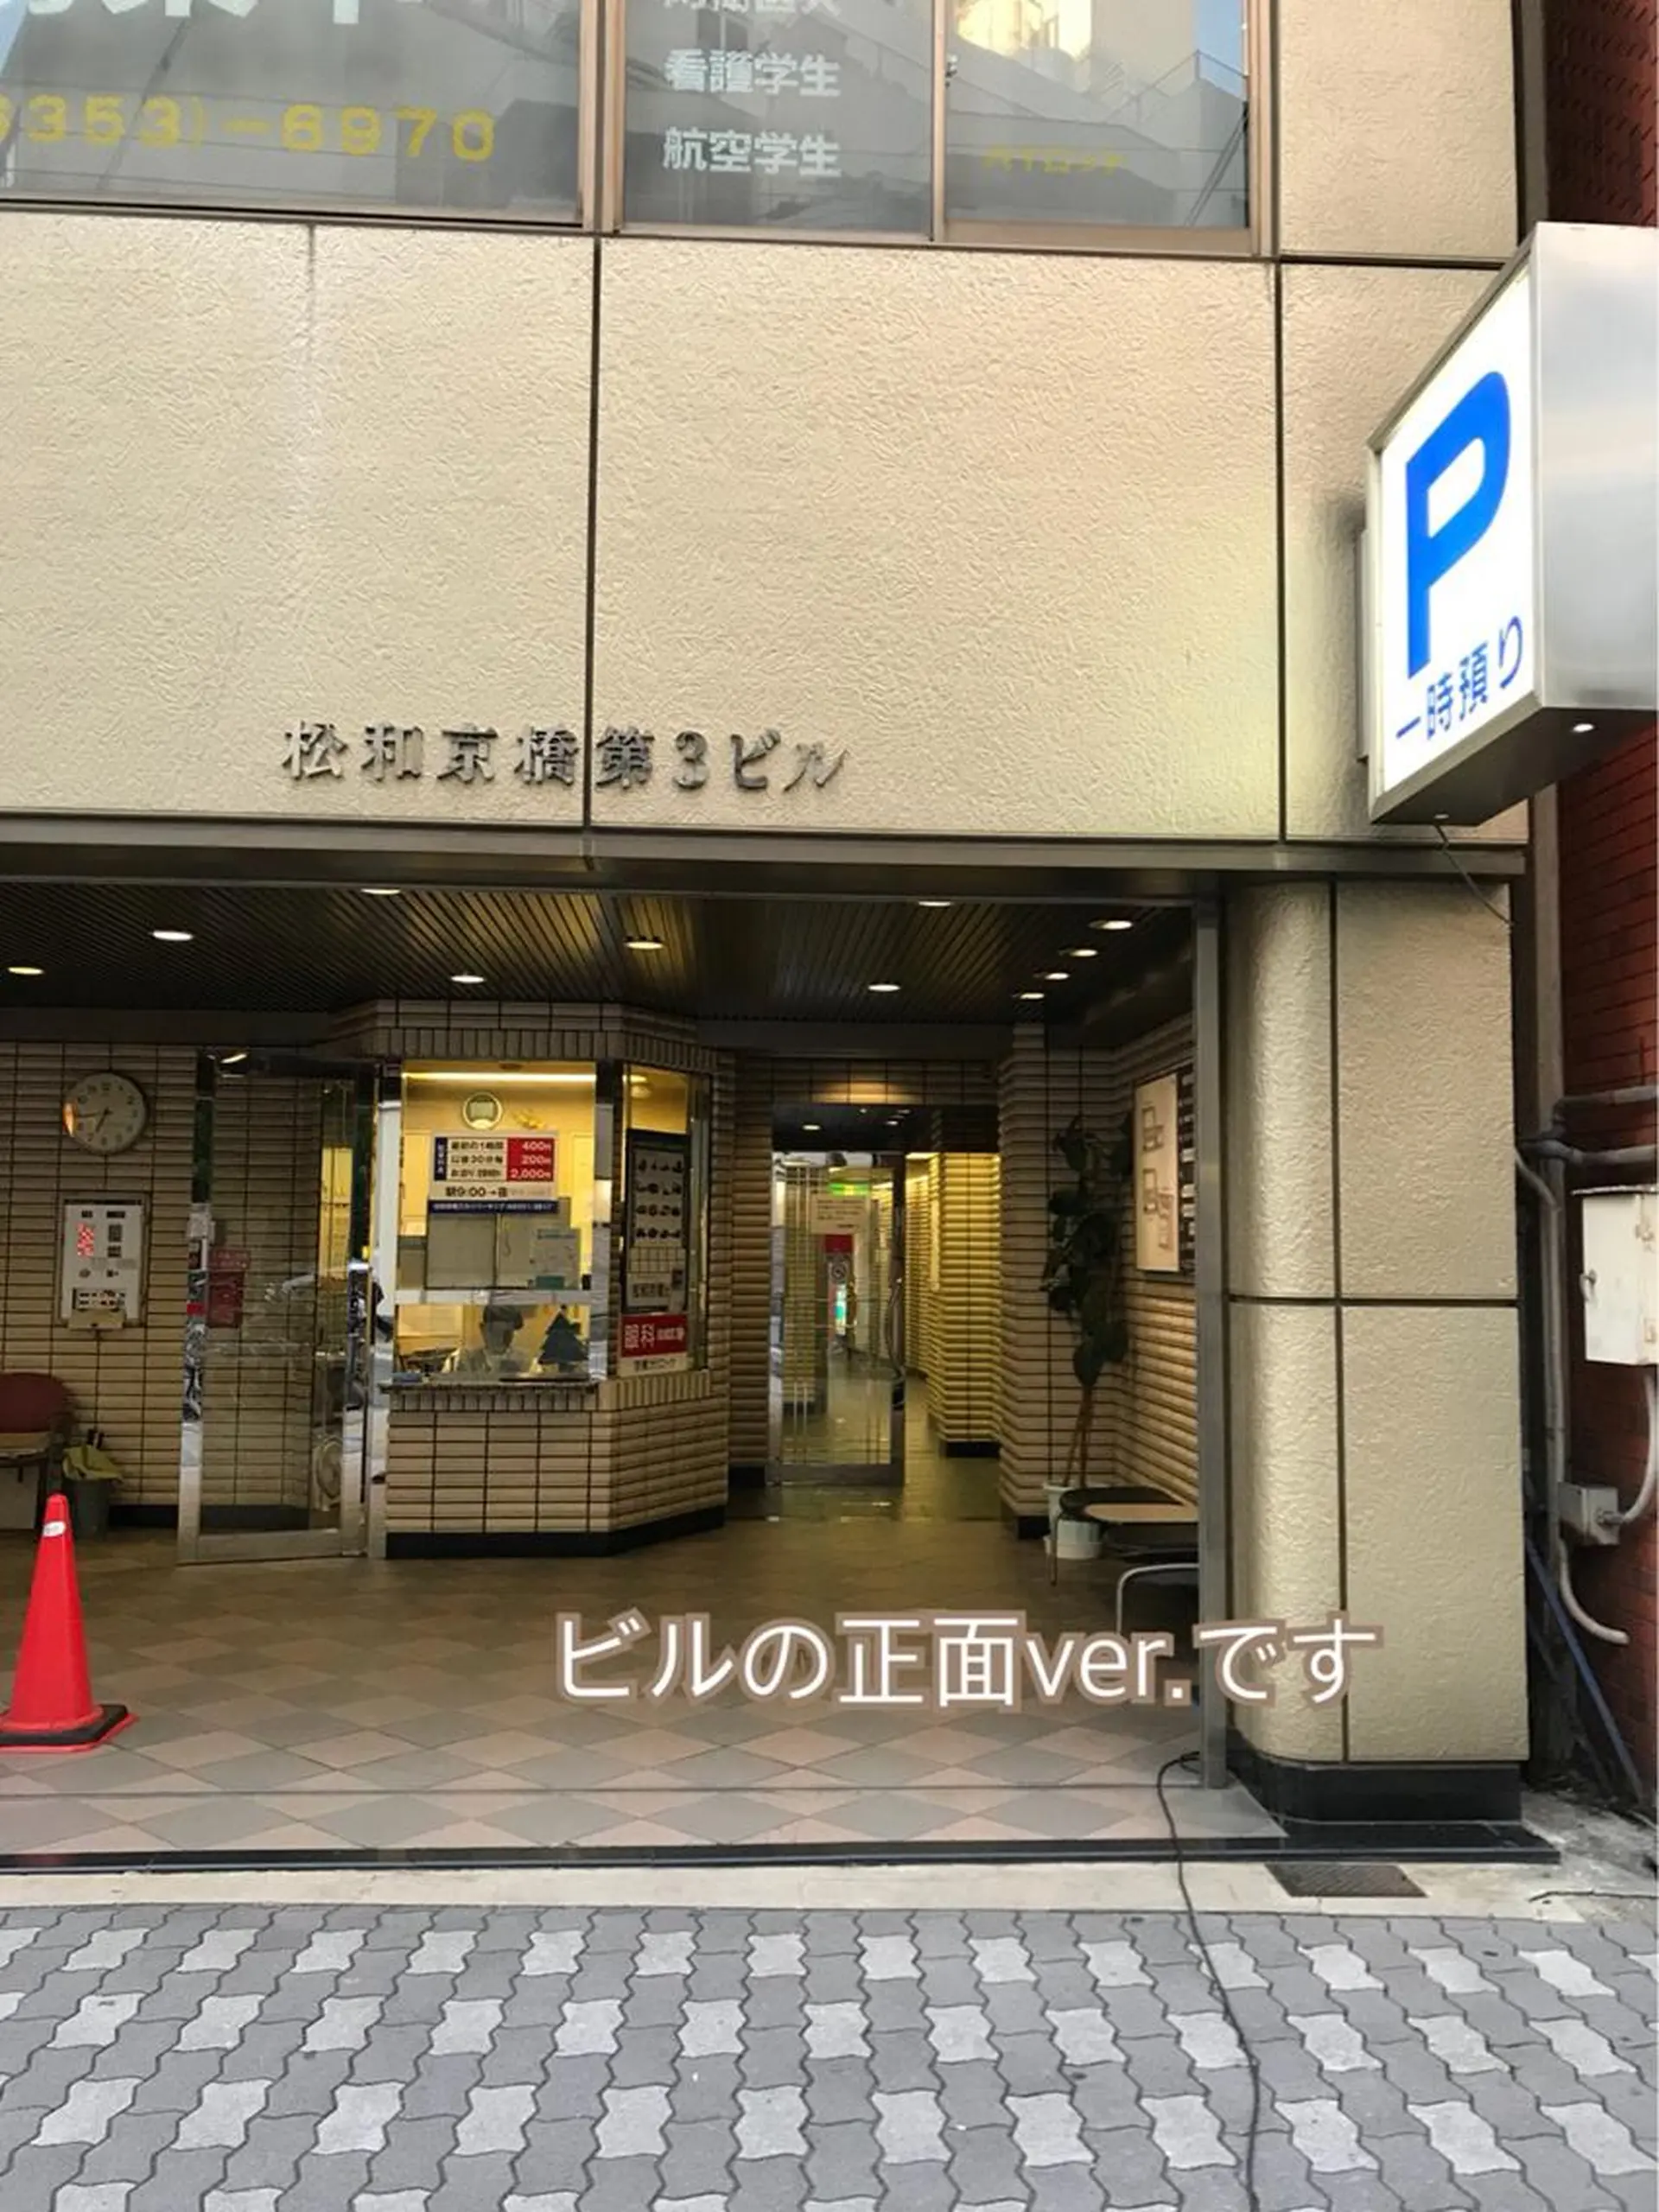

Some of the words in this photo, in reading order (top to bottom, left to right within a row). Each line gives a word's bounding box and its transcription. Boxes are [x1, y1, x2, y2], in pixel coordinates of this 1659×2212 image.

[664, 48, 841, 97] 看護学生
[663, 126, 842, 177] 航空学生
[1406, 371, 1511, 680] P
[1395, 616, 1524, 741] 一時預り
[282, 719, 849, 791] 松和京橋第3ビル
